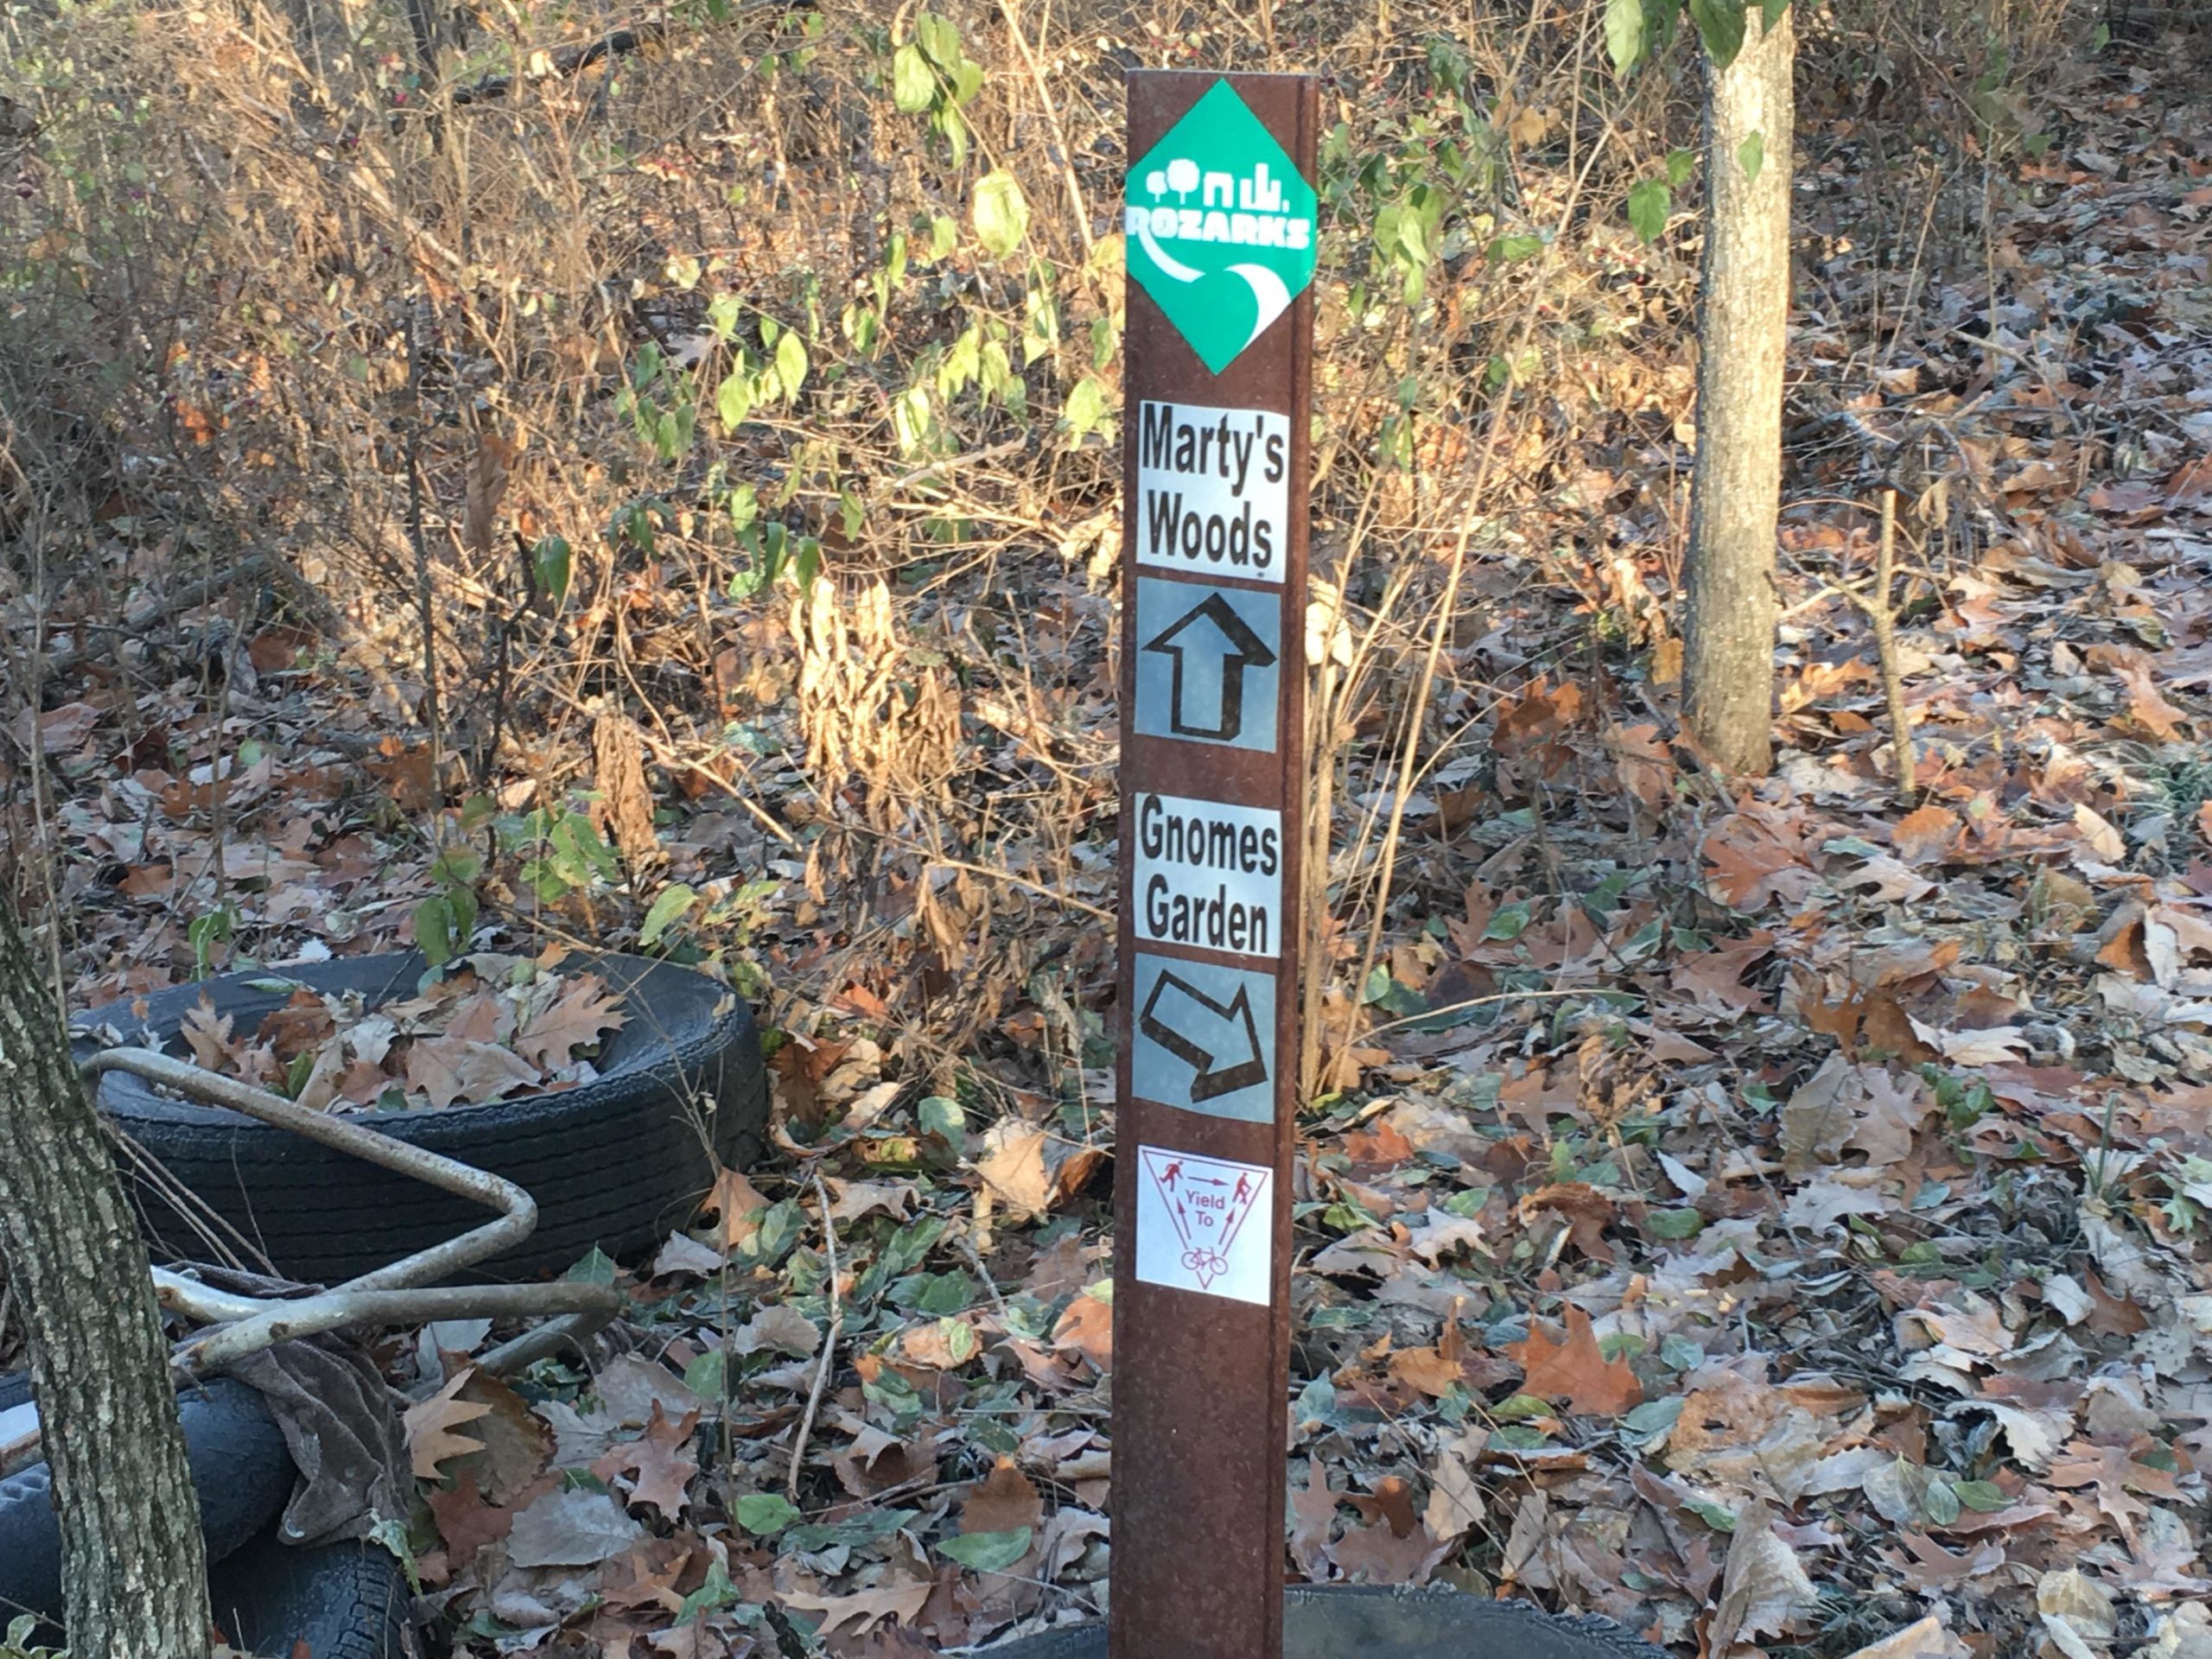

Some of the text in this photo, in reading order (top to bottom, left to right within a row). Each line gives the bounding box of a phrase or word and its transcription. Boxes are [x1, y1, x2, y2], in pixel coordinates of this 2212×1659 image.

[1142, 403, 1285, 497] Marty's
[1147, 489, 1273, 569] Woods
[1141, 794, 1278, 876] Gnomes
[1147, 874, 1268, 953] Garden
[1185, 1189, 1225, 1210] Yield
[1195, 1211, 1214, 1227] To
